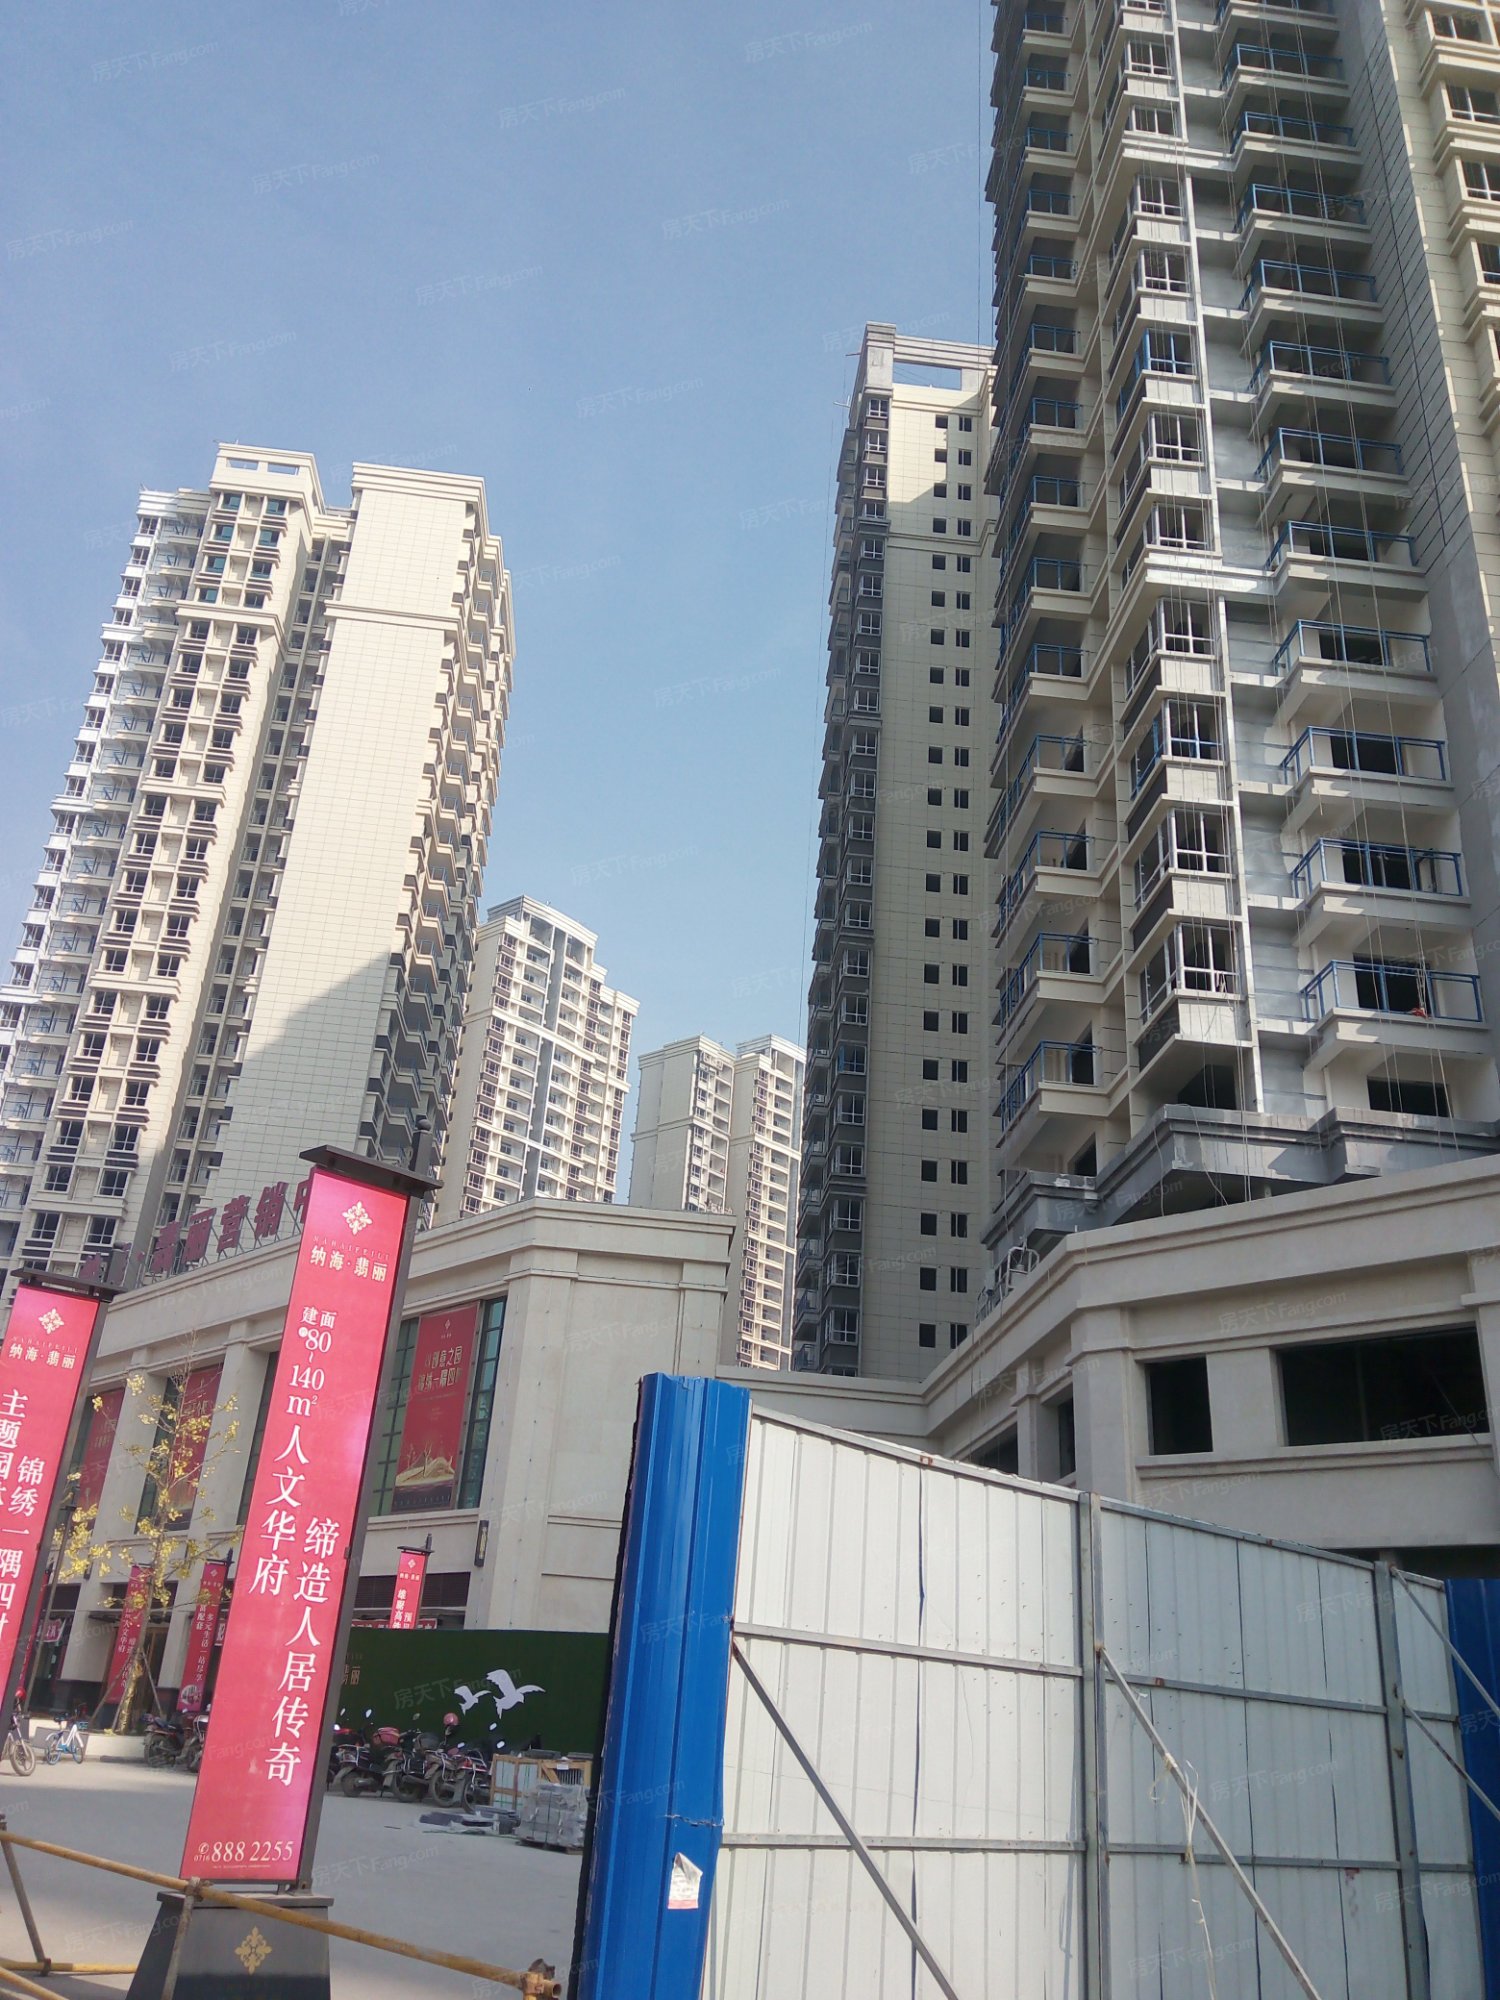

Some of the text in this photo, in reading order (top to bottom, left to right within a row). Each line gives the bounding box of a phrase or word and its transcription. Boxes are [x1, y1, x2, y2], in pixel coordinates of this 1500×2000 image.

[300, 1306, 337, 1329] 建面
[289, 1364, 325, 1390] 140
[248, 1424, 310, 1596] 人文华府
[264, 1516, 341, 1787] 缔造人居传奇
[211, 1841, 246, 1862] 888
[249, 1841, 294, 1861] 2255
